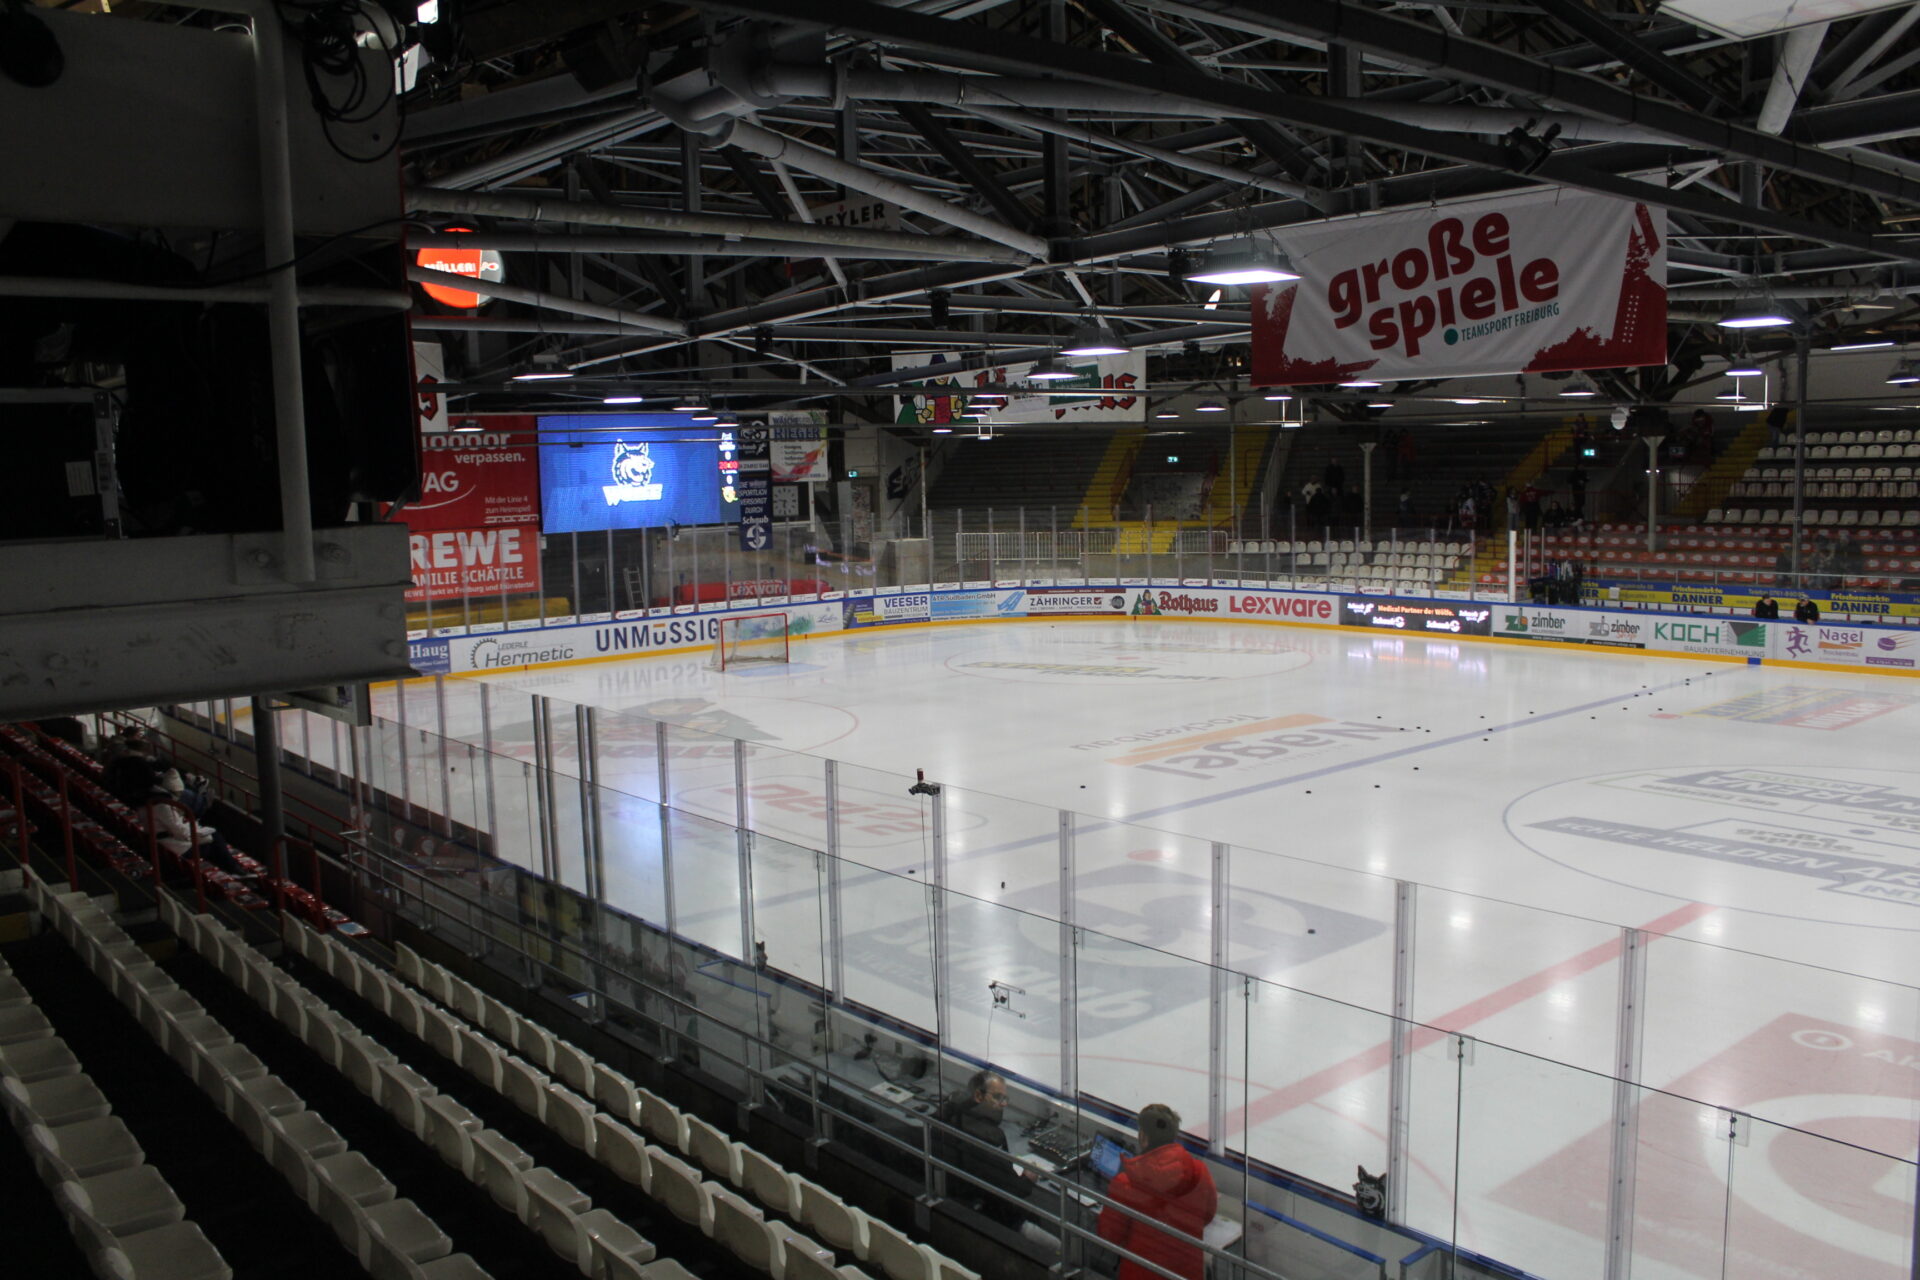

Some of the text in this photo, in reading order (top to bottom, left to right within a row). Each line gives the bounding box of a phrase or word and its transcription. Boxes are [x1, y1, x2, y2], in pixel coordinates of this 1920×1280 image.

[1328, 212, 1511, 329] große
[1369, 254, 1560, 357] spiele
[1461, 302, 1560, 341] TEAMSPORT FREIBURG
[454, 452, 526, 466] verpassen.
[422, 471, 459, 493] AG
[409, 529, 523, 570] REWE
[411, 566, 524, 587] AMILIE SCHÄTZLE
[884, 596, 928, 608] VEESER
[1030, 596, 1092, 606] ZÄHRINGER
[1158, 591, 1218, 614] Rothaus
[1229, 595, 1332, 618] Lexware
[1672, 593, 1723, 605] DANNER
[1831, 601, 1890, 614] DANNER
[1531, 611, 1565, 629] zimber
[1611, 619, 1640, 633] zimber
[1655, 622, 1720, 644] KOCH
[1819, 628, 1863, 645] Nagel
[409, 644, 449, 659] Haug
[485, 644, 574, 668] Hermetic
[1133, 720, 1413, 781] Nagel
[1695, 775, 1887, 805] ARENA
[1653, 836, 1840, 870] HELDEN
